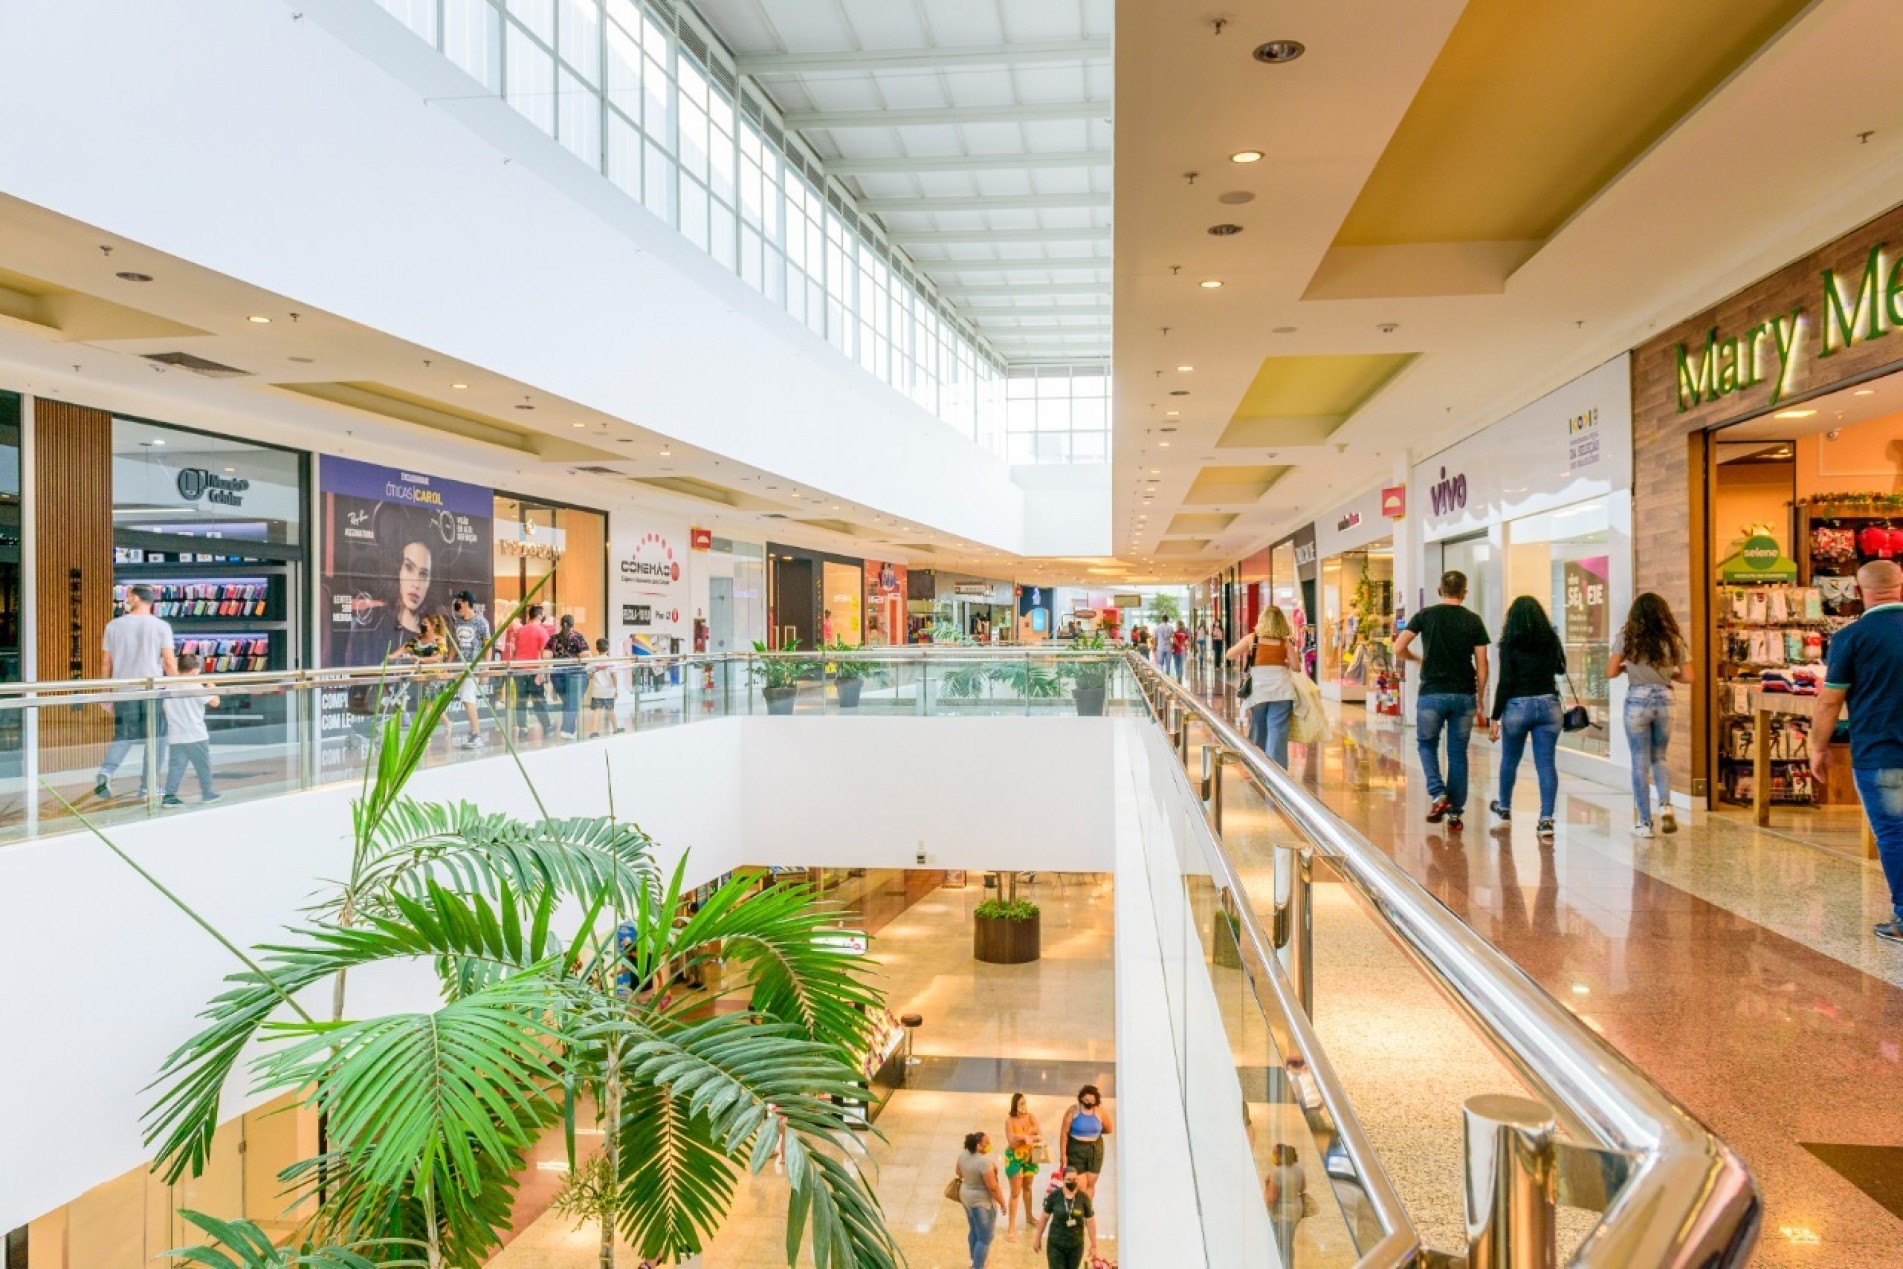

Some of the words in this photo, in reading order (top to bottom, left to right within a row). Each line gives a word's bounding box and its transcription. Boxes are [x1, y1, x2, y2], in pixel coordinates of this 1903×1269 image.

[1675, 306, 1804, 413] Mary
[385, 481, 413, 500] ÓTICAS
[414, 488, 443, 506] CAROL
[1430, 466, 1467, 517] vivo
[1743, 547, 1779, 558] selene
